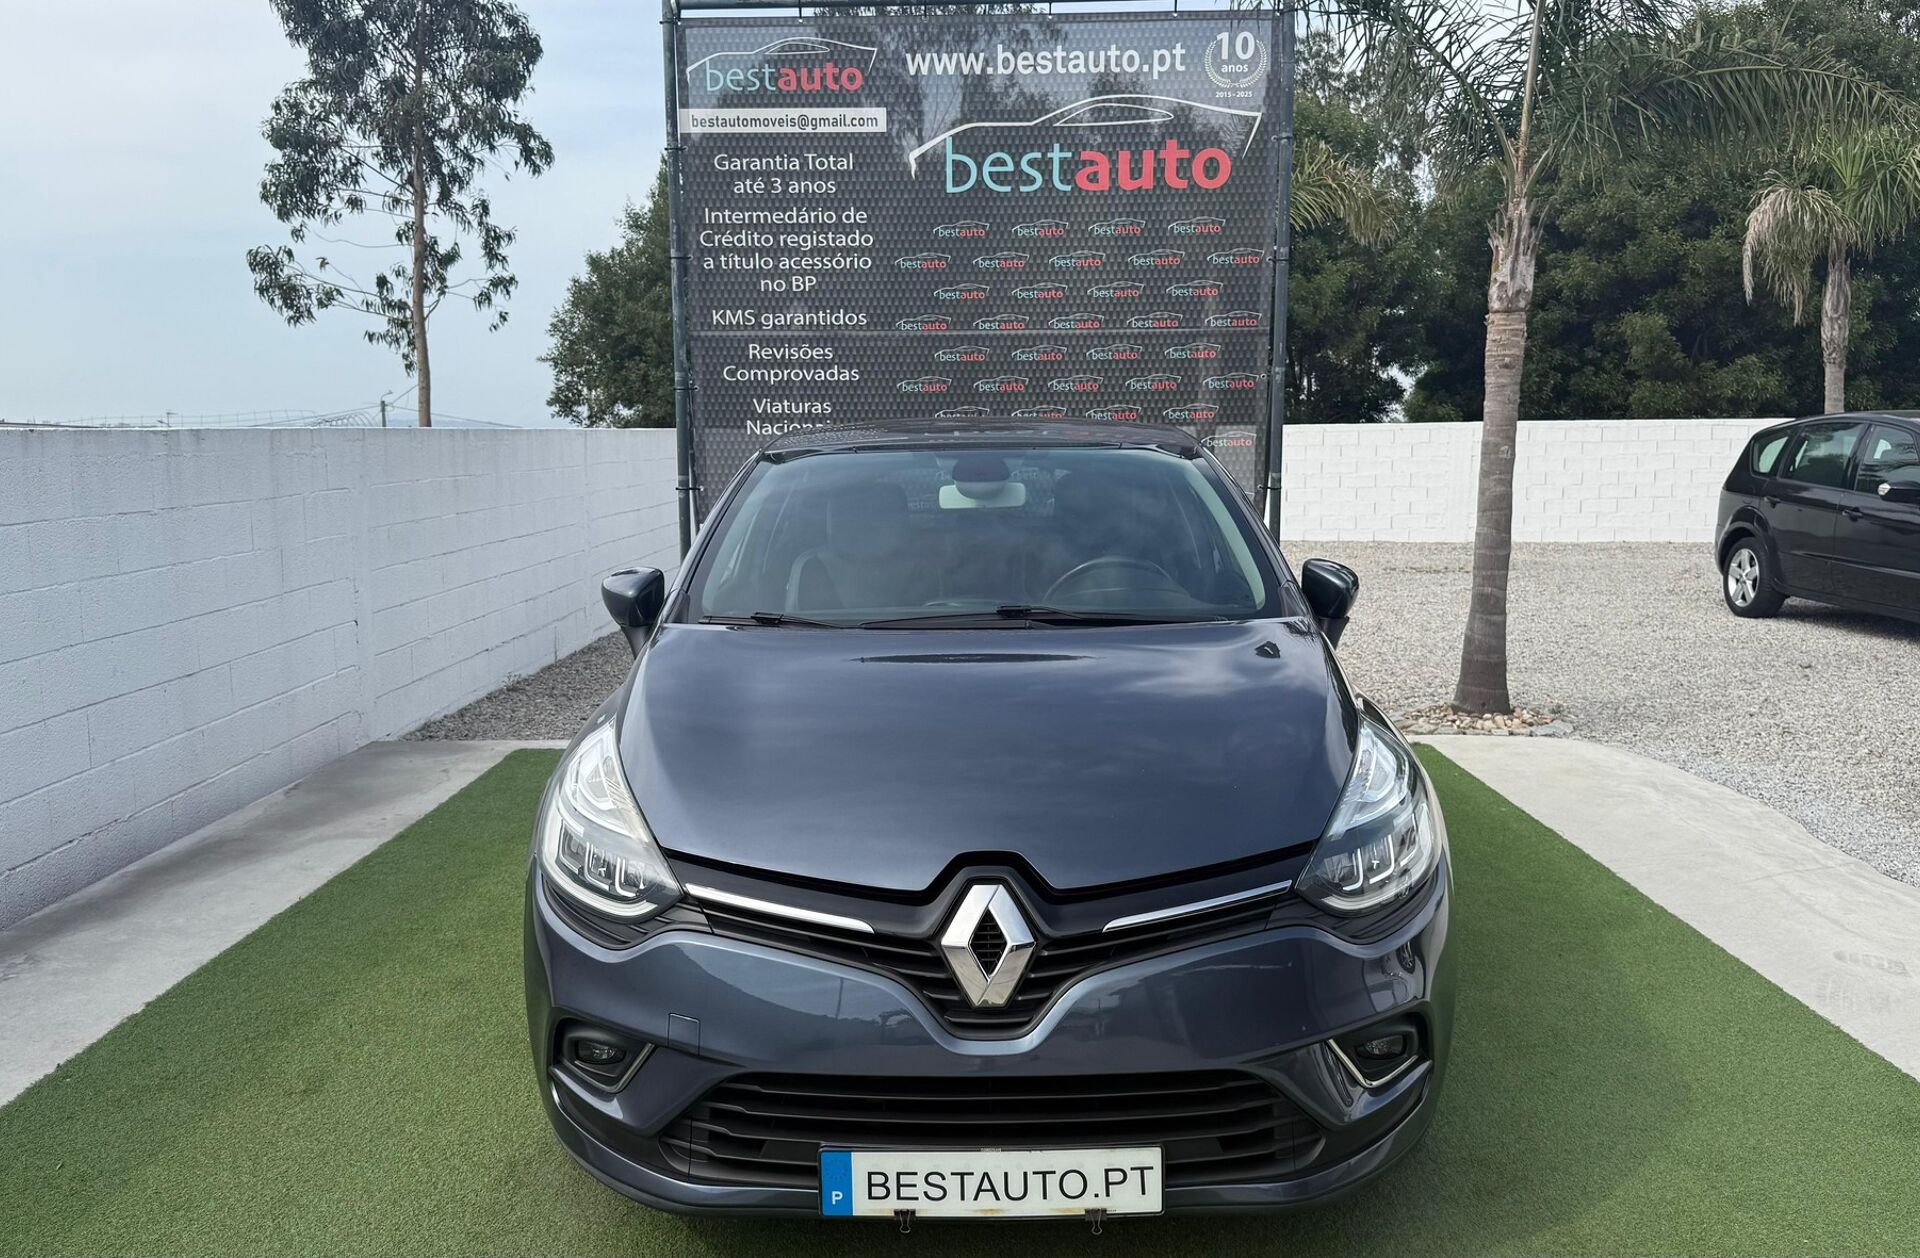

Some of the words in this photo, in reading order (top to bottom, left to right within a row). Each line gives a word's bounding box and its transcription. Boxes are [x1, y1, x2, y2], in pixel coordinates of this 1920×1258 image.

[1216, 31, 1256, 60] 10
[906, 42, 1186, 80] www.bestauto.pt
[1221, 64, 1249, 73] anos
[706, 60, 863, 92] bestauto
[691, 114, 879, 130] bestautomoveis@gmail.com
[714, 154, 800, 171] Garantia
[804, 153, 853, 171] Total
[946, 136, 1232, 193] bestauto
[734, 177, 765, 194] até
[771, 178, 782, 194] 3
[788, 180, 836, 194] anos
[704, 207, 836, 224] Intermedário
[842, 207, 868, 224] de
[938, 226, 985, 237] bestauto
[1017, 225, 1064, 236] bestauto
[1094, 223, 1141, 235] bestauto
[1173, 222, 1222, 234] bestauto
[700, 230, 774, 247] Crédito
[780, 230, 874, 250] registado
[703, 257, 714, 270] a
[720, 253, 773, 270] título
[779, 253, 872, 270] acessório
[900, 258, 947, 269] bestauto
[978, 257, 1025, 268] bestauto
[1054, 256, 1101, 267] bestauto
[1133, 254, 1181, 266] bestauto
[1212, 254, 1260, 264] bestauto
[760, 279, 786, 292] no
[792, 276, 817, 292] BP
[939, 289, 985, 300] bestauto
[1016, 288, 1064, 299] bestauto
[1092, 287, 1140, 298] bestauto
[1172, 286, 1219, 297] bestauto
[712, 309, 756, 326] KMS
[761, 309, 867, 330] garantidos
[901, 320, 948, 330] bestauto
[978, 320, 1025, 330] bestauto
[1053, 318, 1100, 328] bestauto
[1132, 317, 1179, 328] bestauto
[1210, 316, 1257, 328] bestauto
[749, 344, 834, 360] Revisões
[939, 350, 986, 362] bestauto
[1017, 350, 1063, 361] bestauto
[1092, 349, 1138, 360] bestauto
[1170, 348, 1216, 360] bestauto
[723, 365, 860, 384] Comprovadas
[902, 381, 948, 392] bestauto
[978, 380, 1025, 392] bestauto
[1053, 380, 1099, 391] bestauto
[1130, 378, 1178, 390] bestauto
[1208, 378, 1255, 389] bestauto
[752, 398, 832, 414] Viaturas
[1091, 410, 1137, 420] bestauto
[1168, 409, 1215, 420] bestauto
[1206, 437, 1253, 447] bestauto
[867, 1166, 1154, 1202] BESTAUTO.PT
[832, 1191, 843, 1205] P
